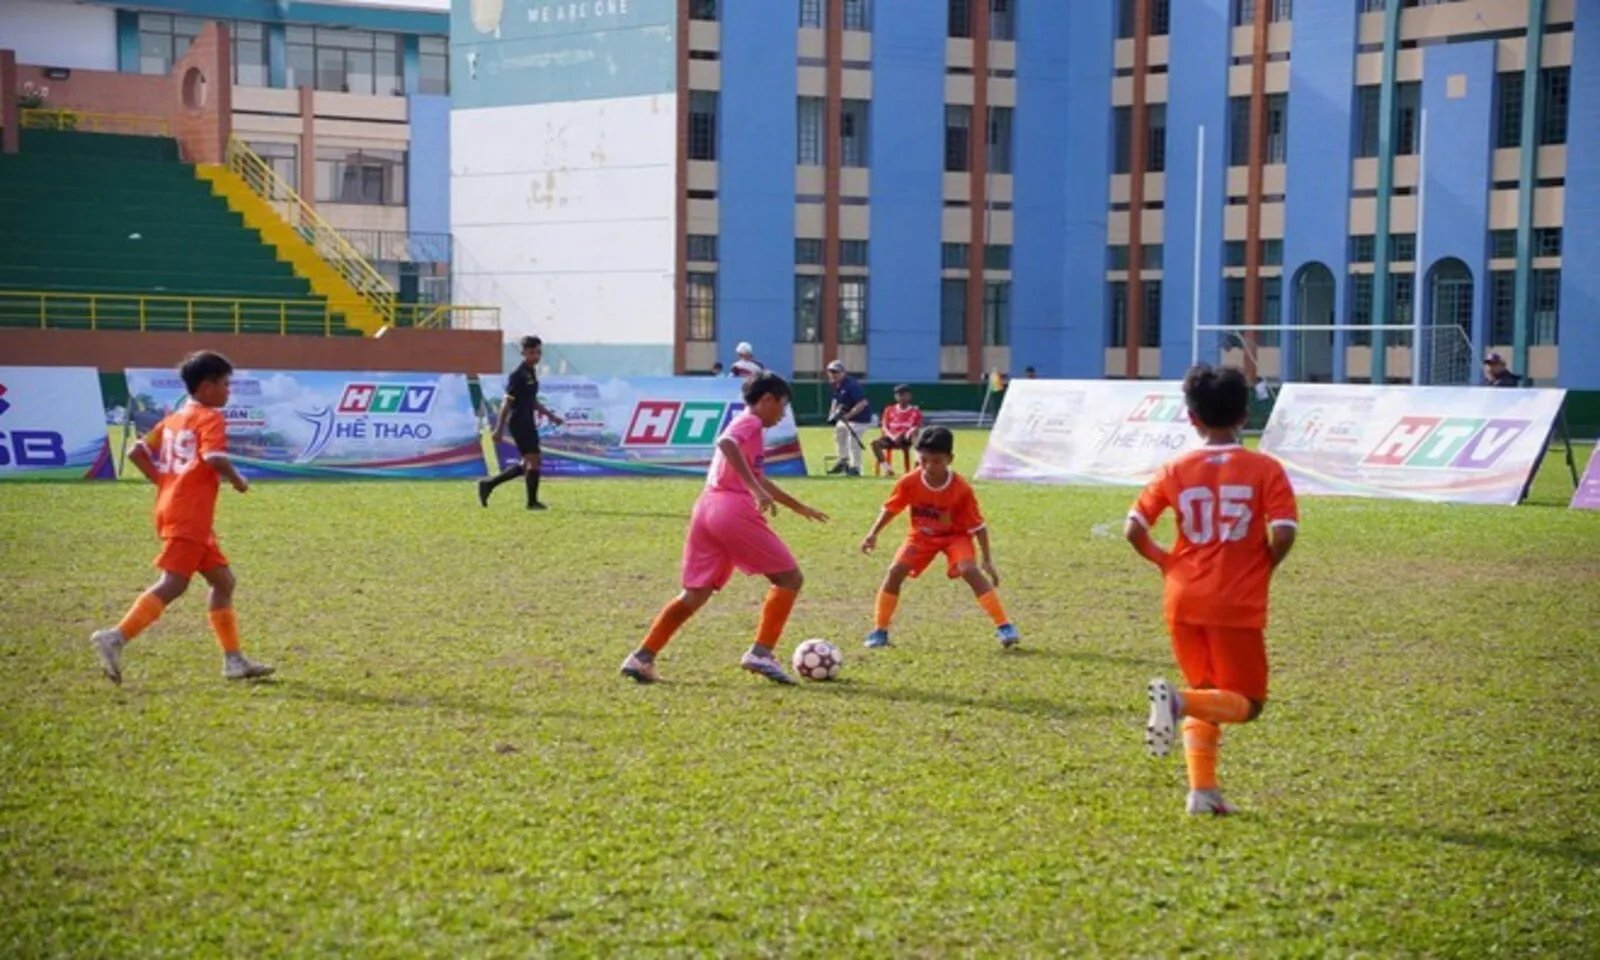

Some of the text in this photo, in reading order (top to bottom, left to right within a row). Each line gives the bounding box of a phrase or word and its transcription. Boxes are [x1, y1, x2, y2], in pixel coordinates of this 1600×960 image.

[528, 7, 549, 22] WE
[342, 386, 431, 410] HTV
[373, 423, 433, 439] THAO
[1141, 433, 1187, 450] THAO
[1374, 424, 1521, 464] HTV
[1179, 485, 1253, 544] 05
